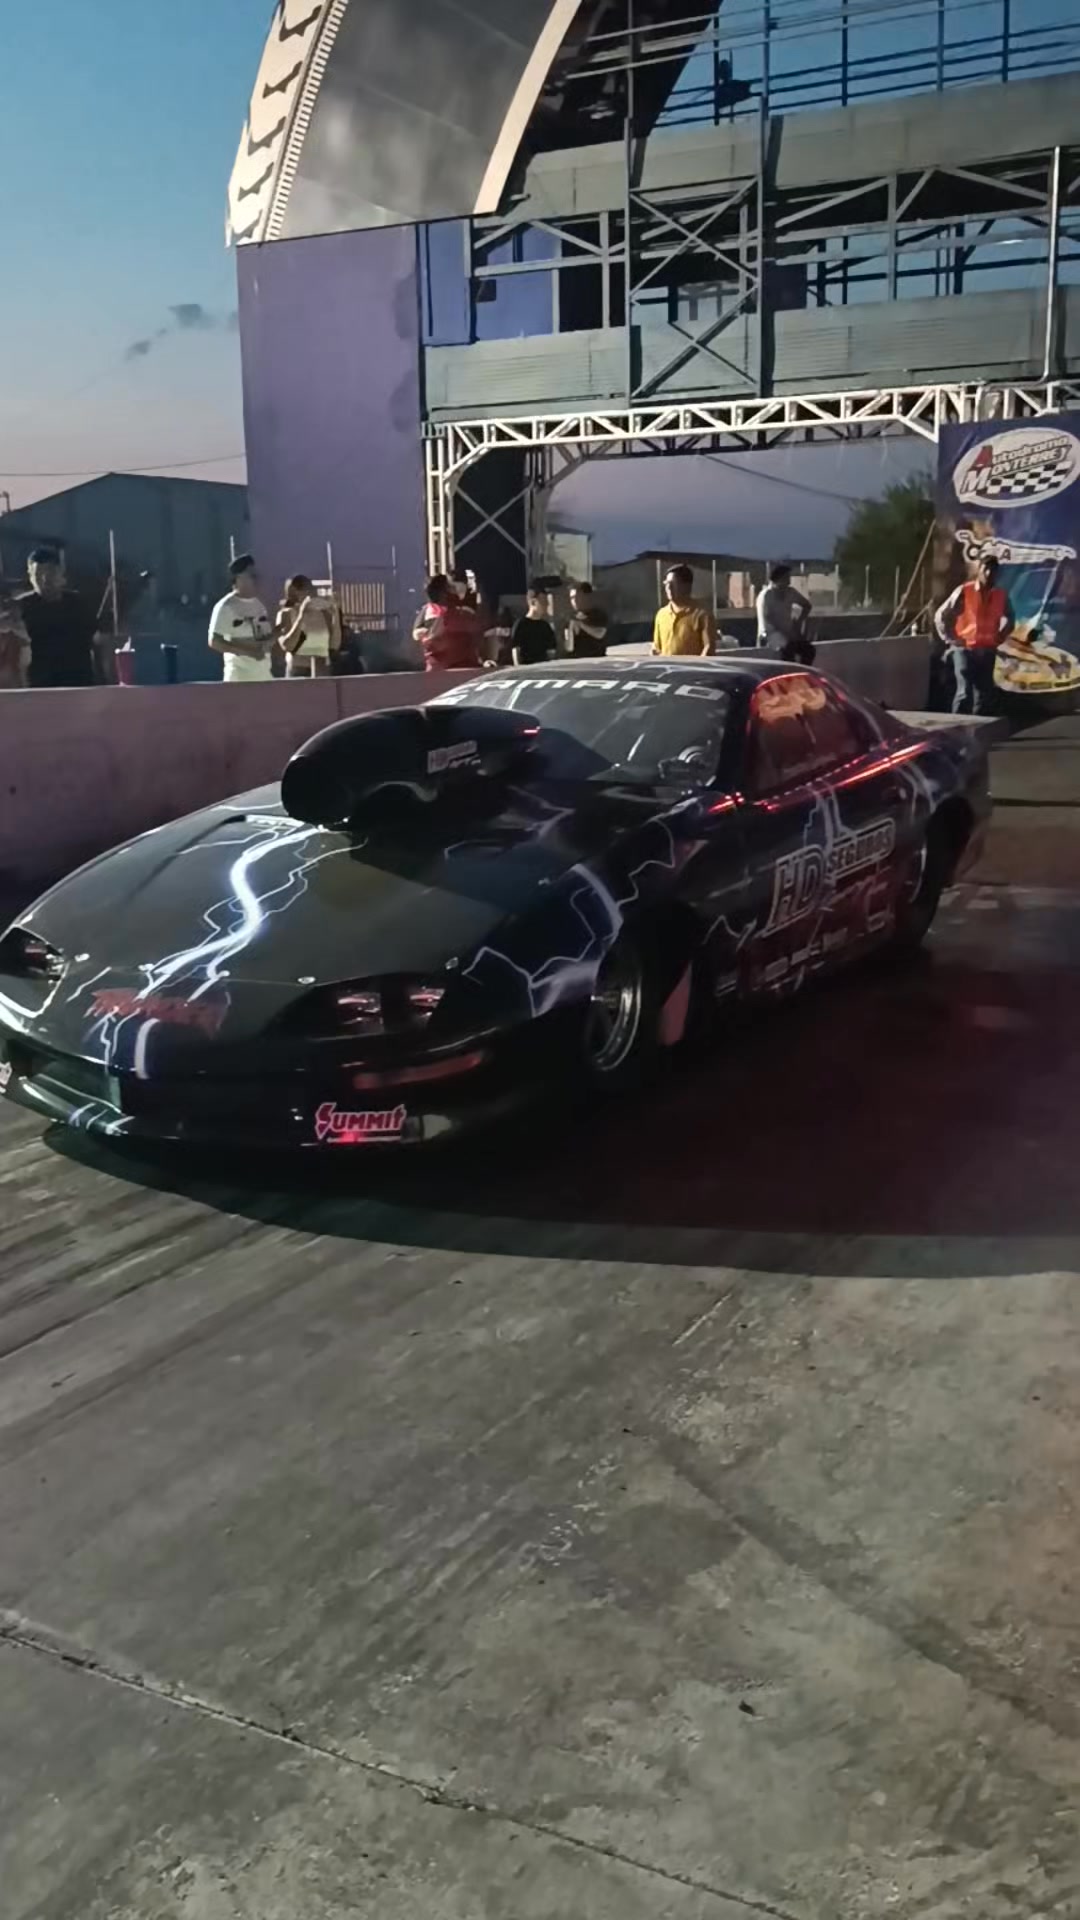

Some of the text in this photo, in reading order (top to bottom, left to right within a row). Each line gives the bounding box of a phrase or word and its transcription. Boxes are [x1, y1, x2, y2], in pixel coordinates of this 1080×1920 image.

[960, 445, 1072, 494] MONTERREY
[968, 435, 1069, 471] Autodromo
[440, 679, 727, 701] CAMARO
